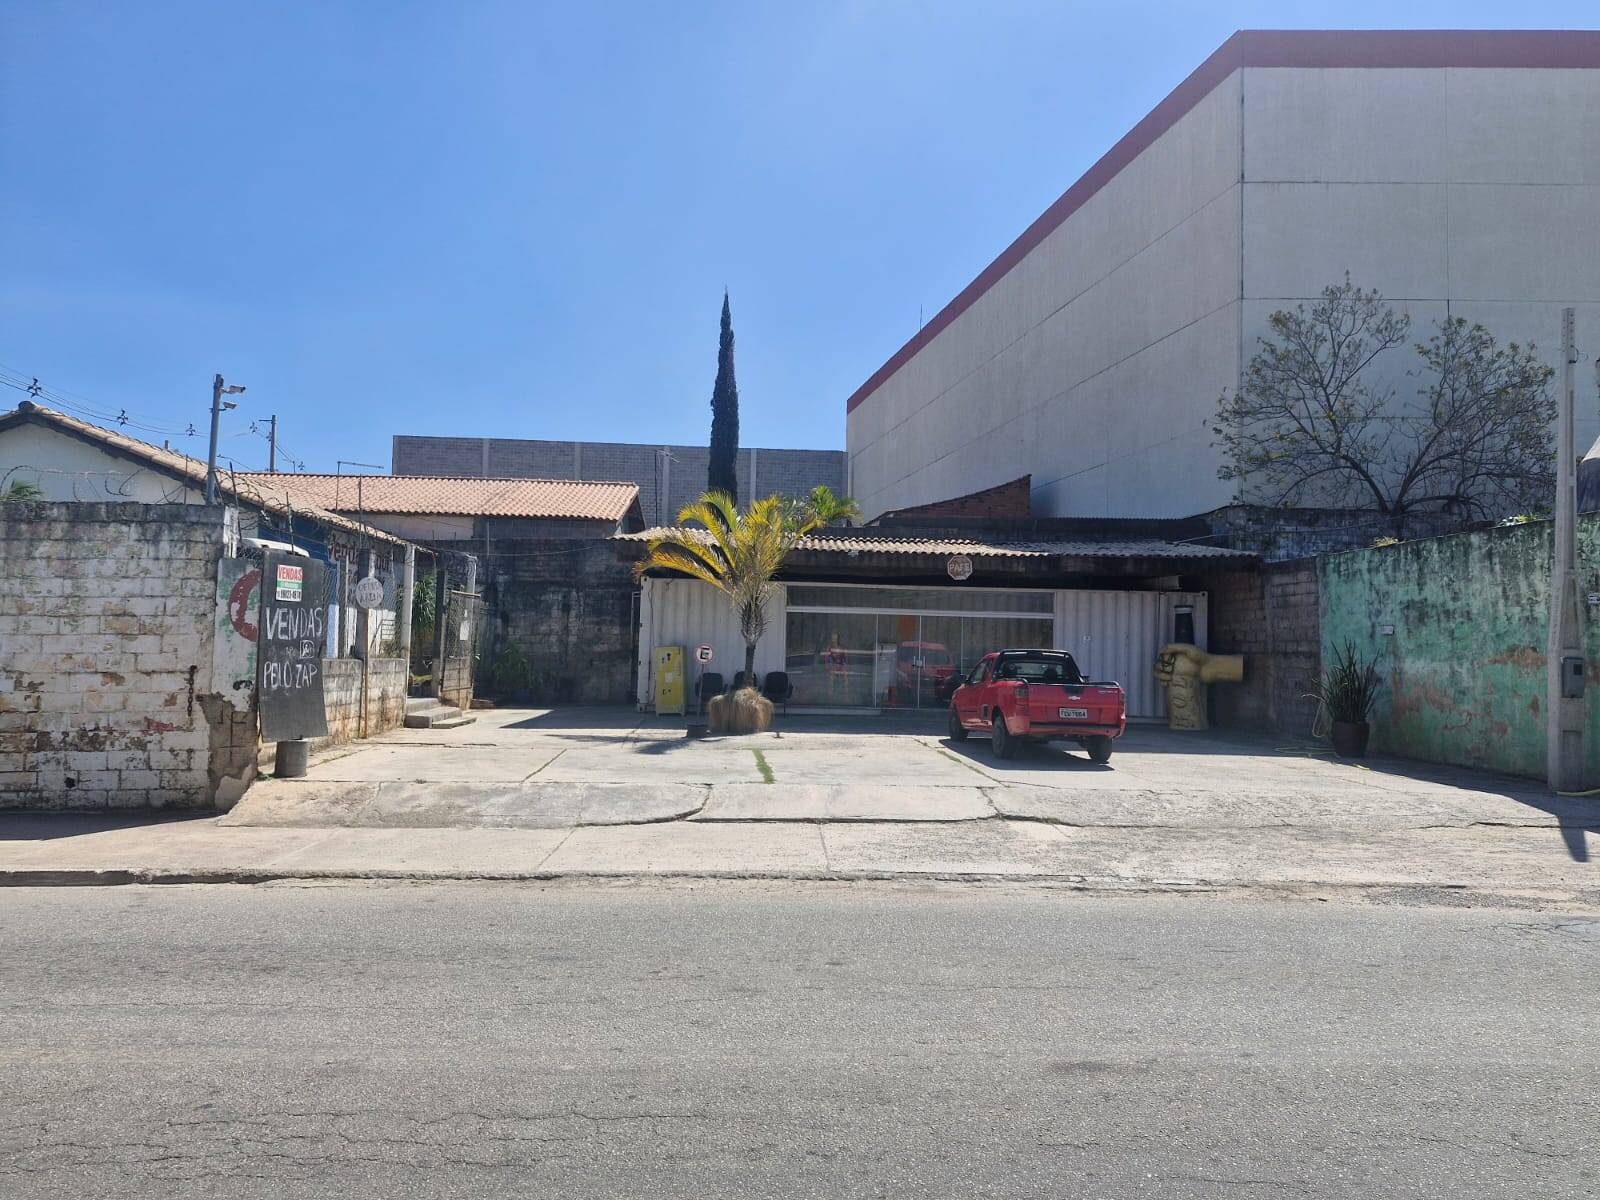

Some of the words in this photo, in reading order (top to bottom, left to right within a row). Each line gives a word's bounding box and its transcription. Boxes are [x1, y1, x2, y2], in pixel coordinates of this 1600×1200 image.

[278, 567, 303, 581] VENDAS
[265, 607, 323, 640] VENDAS
[295, 663, 318, 689] ZAP
